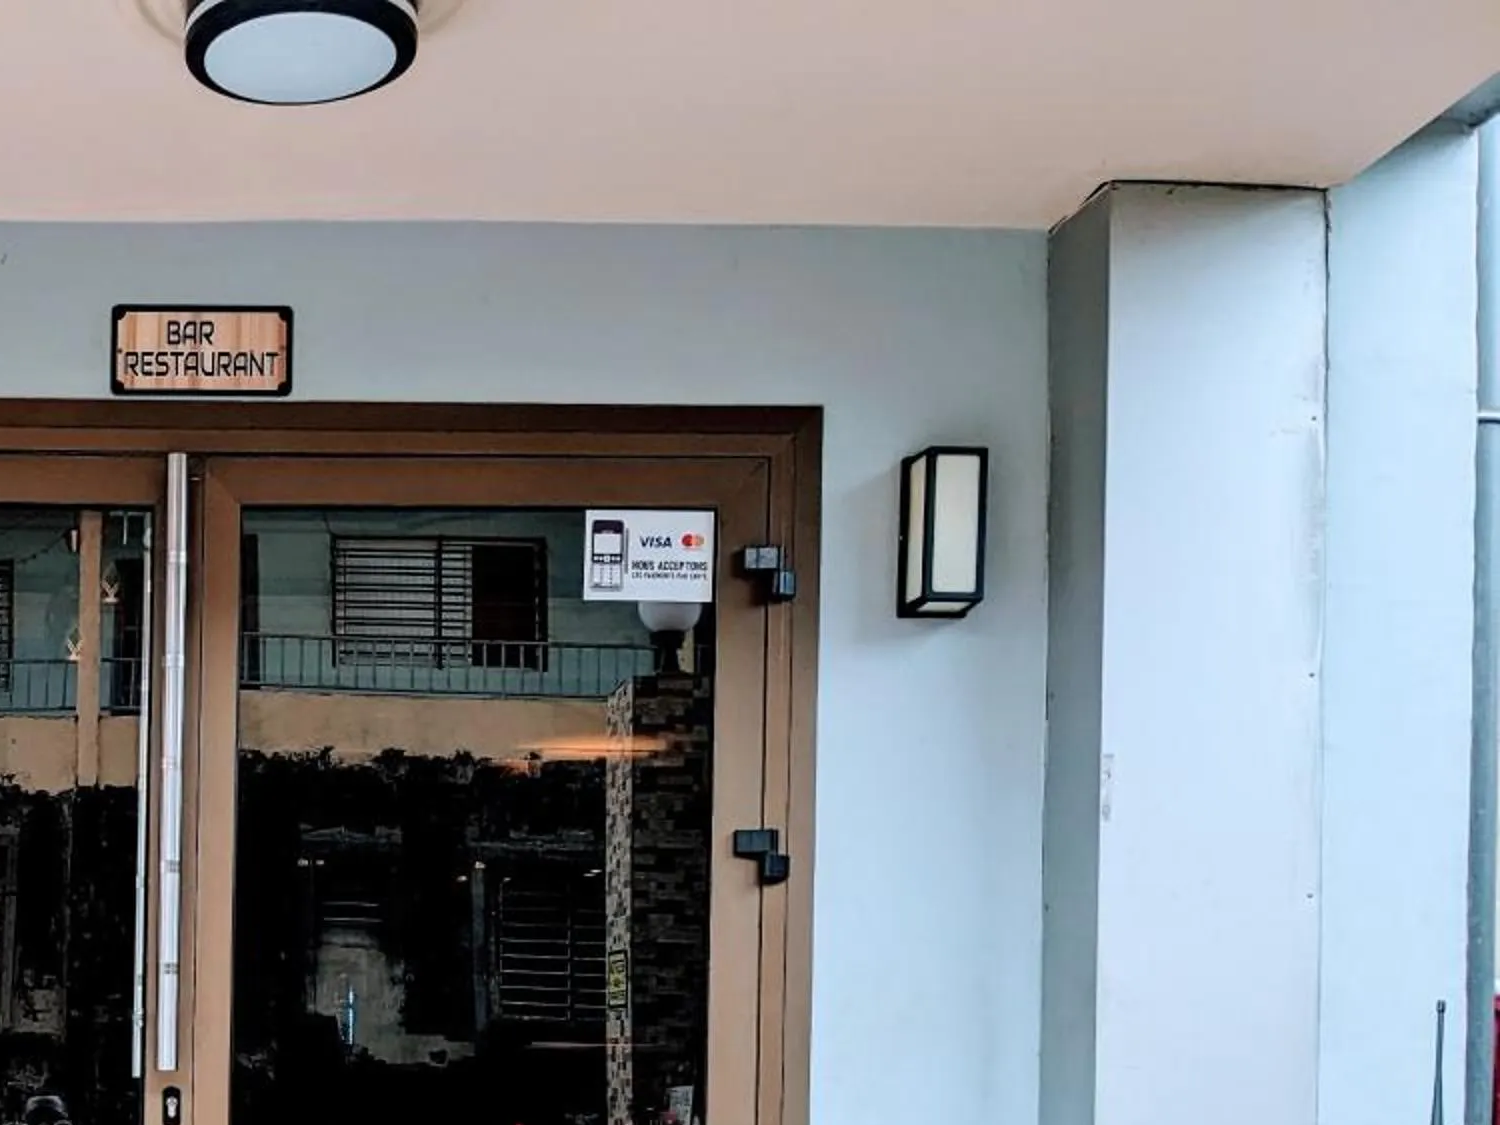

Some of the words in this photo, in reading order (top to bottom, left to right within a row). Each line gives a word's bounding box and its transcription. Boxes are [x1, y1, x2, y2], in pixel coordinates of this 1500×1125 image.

[167, 320, 215, 345] BAR
[124, 351, 280, 377] RESTAURANT
[640, 536, 672, 548] VISA
